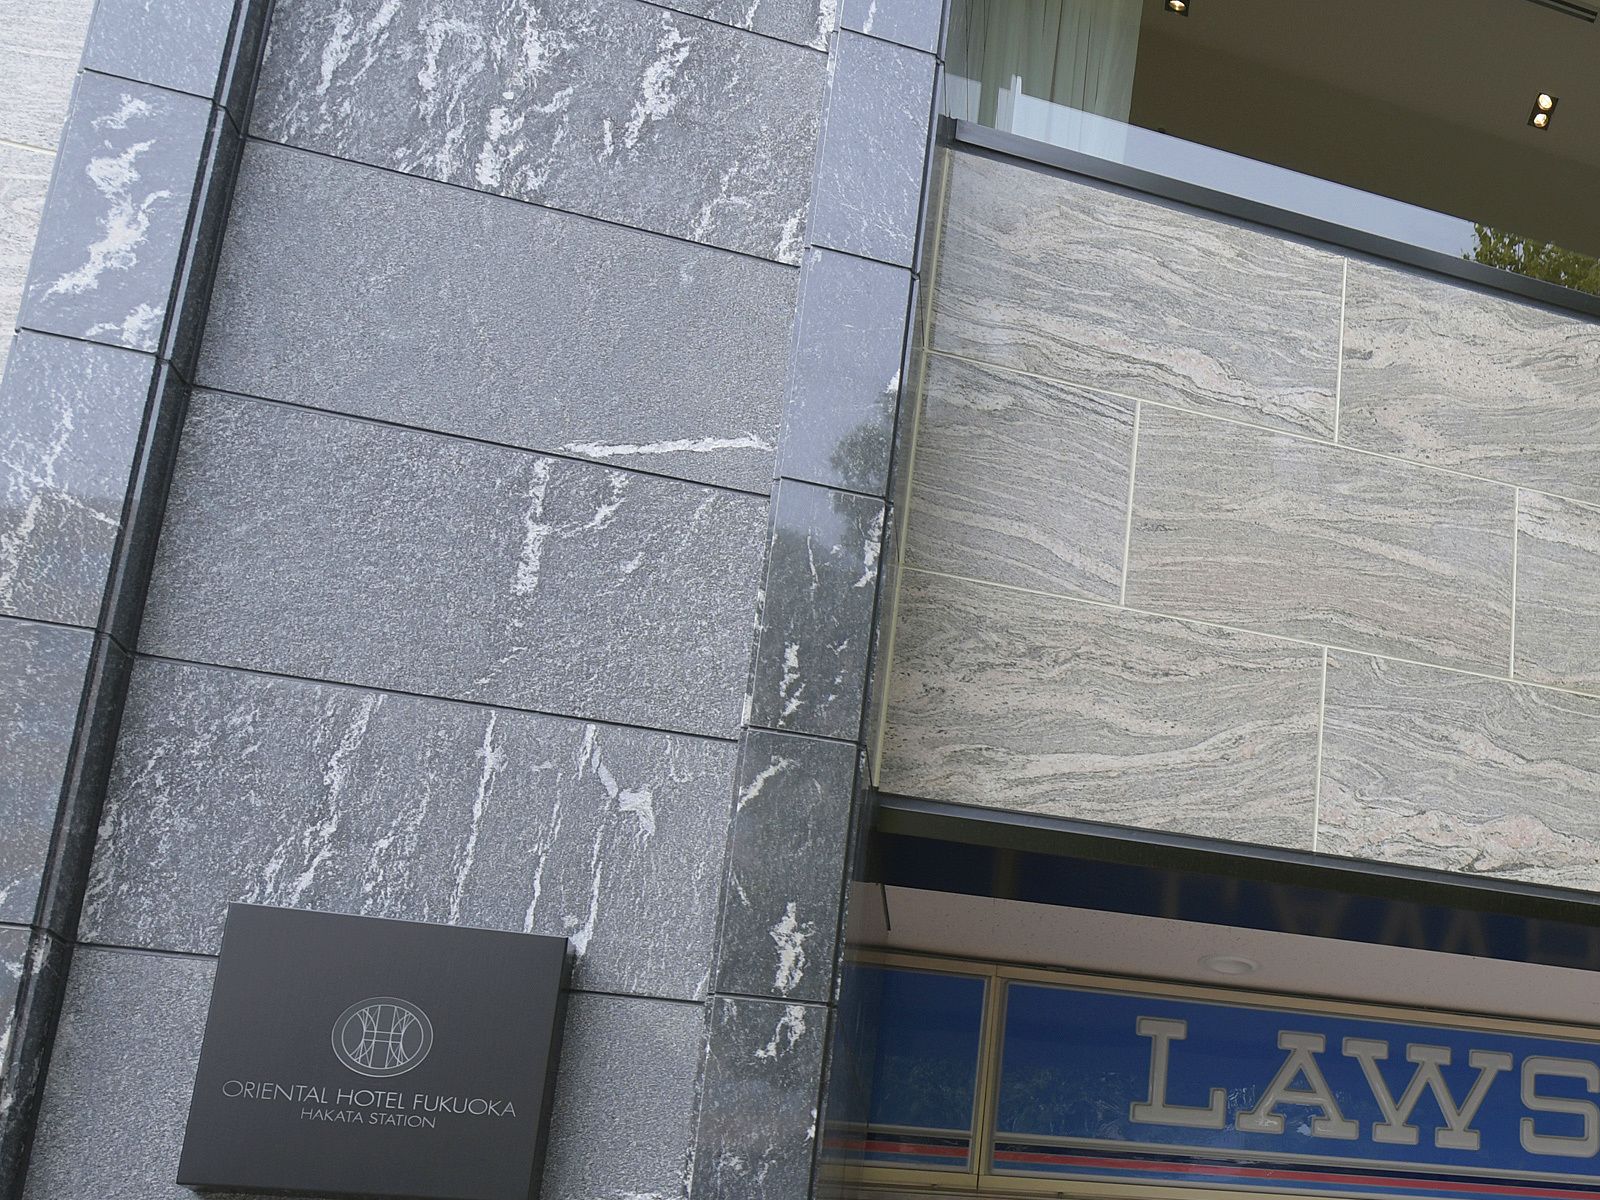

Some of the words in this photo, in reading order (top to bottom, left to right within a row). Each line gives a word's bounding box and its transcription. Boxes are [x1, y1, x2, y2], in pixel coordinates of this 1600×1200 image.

[222, 1080, 328, 1104] ORIENTAL
[336, 1088, 405, 1110] HOTEL
[413, 1093, 517, 1118] FUKUOKA
[301, 1107, 364, 1125] HAKATA
[369, 1112, 436, 1129] STATION
